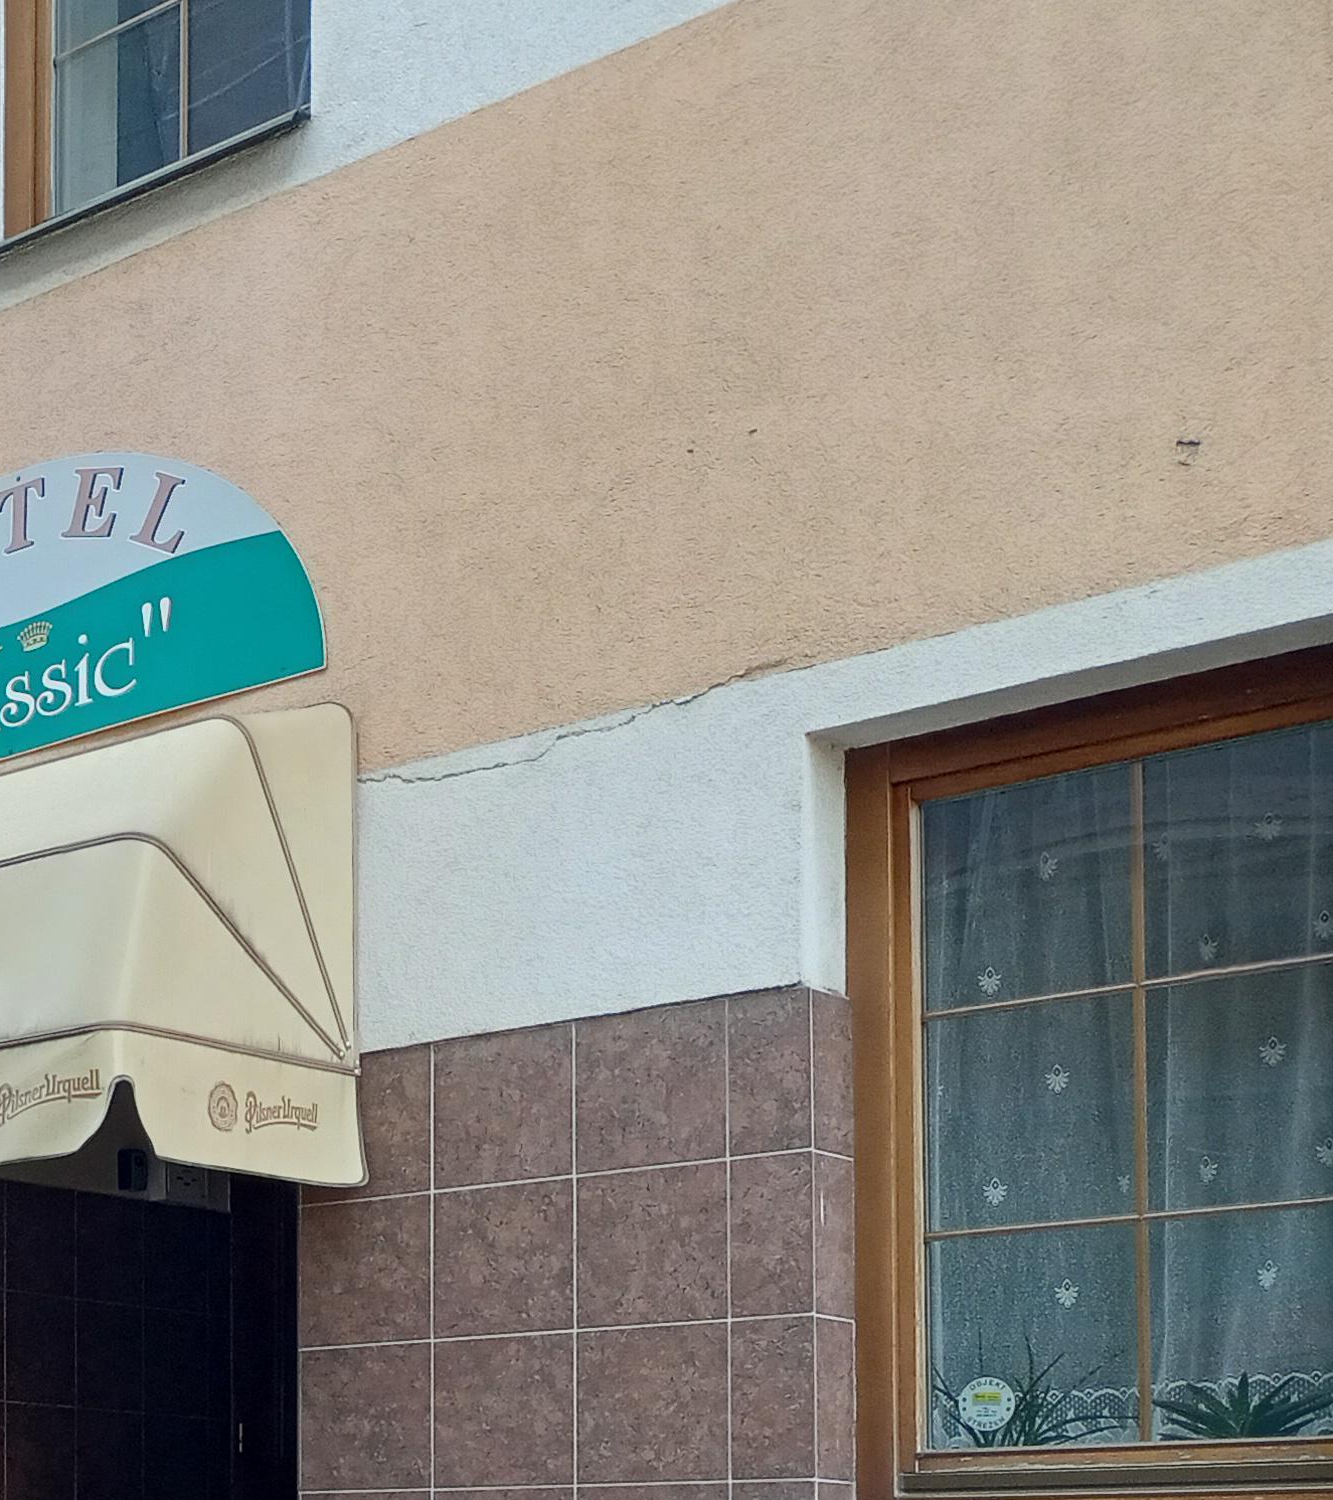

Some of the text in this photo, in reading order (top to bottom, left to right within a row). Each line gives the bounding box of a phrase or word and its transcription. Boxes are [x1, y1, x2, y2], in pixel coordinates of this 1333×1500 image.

[44, 1068, 102, 1103] Urquell
[245, 1091, 282, 1135] Pilsner
[280, 1094, 318, 1131] Urquell
